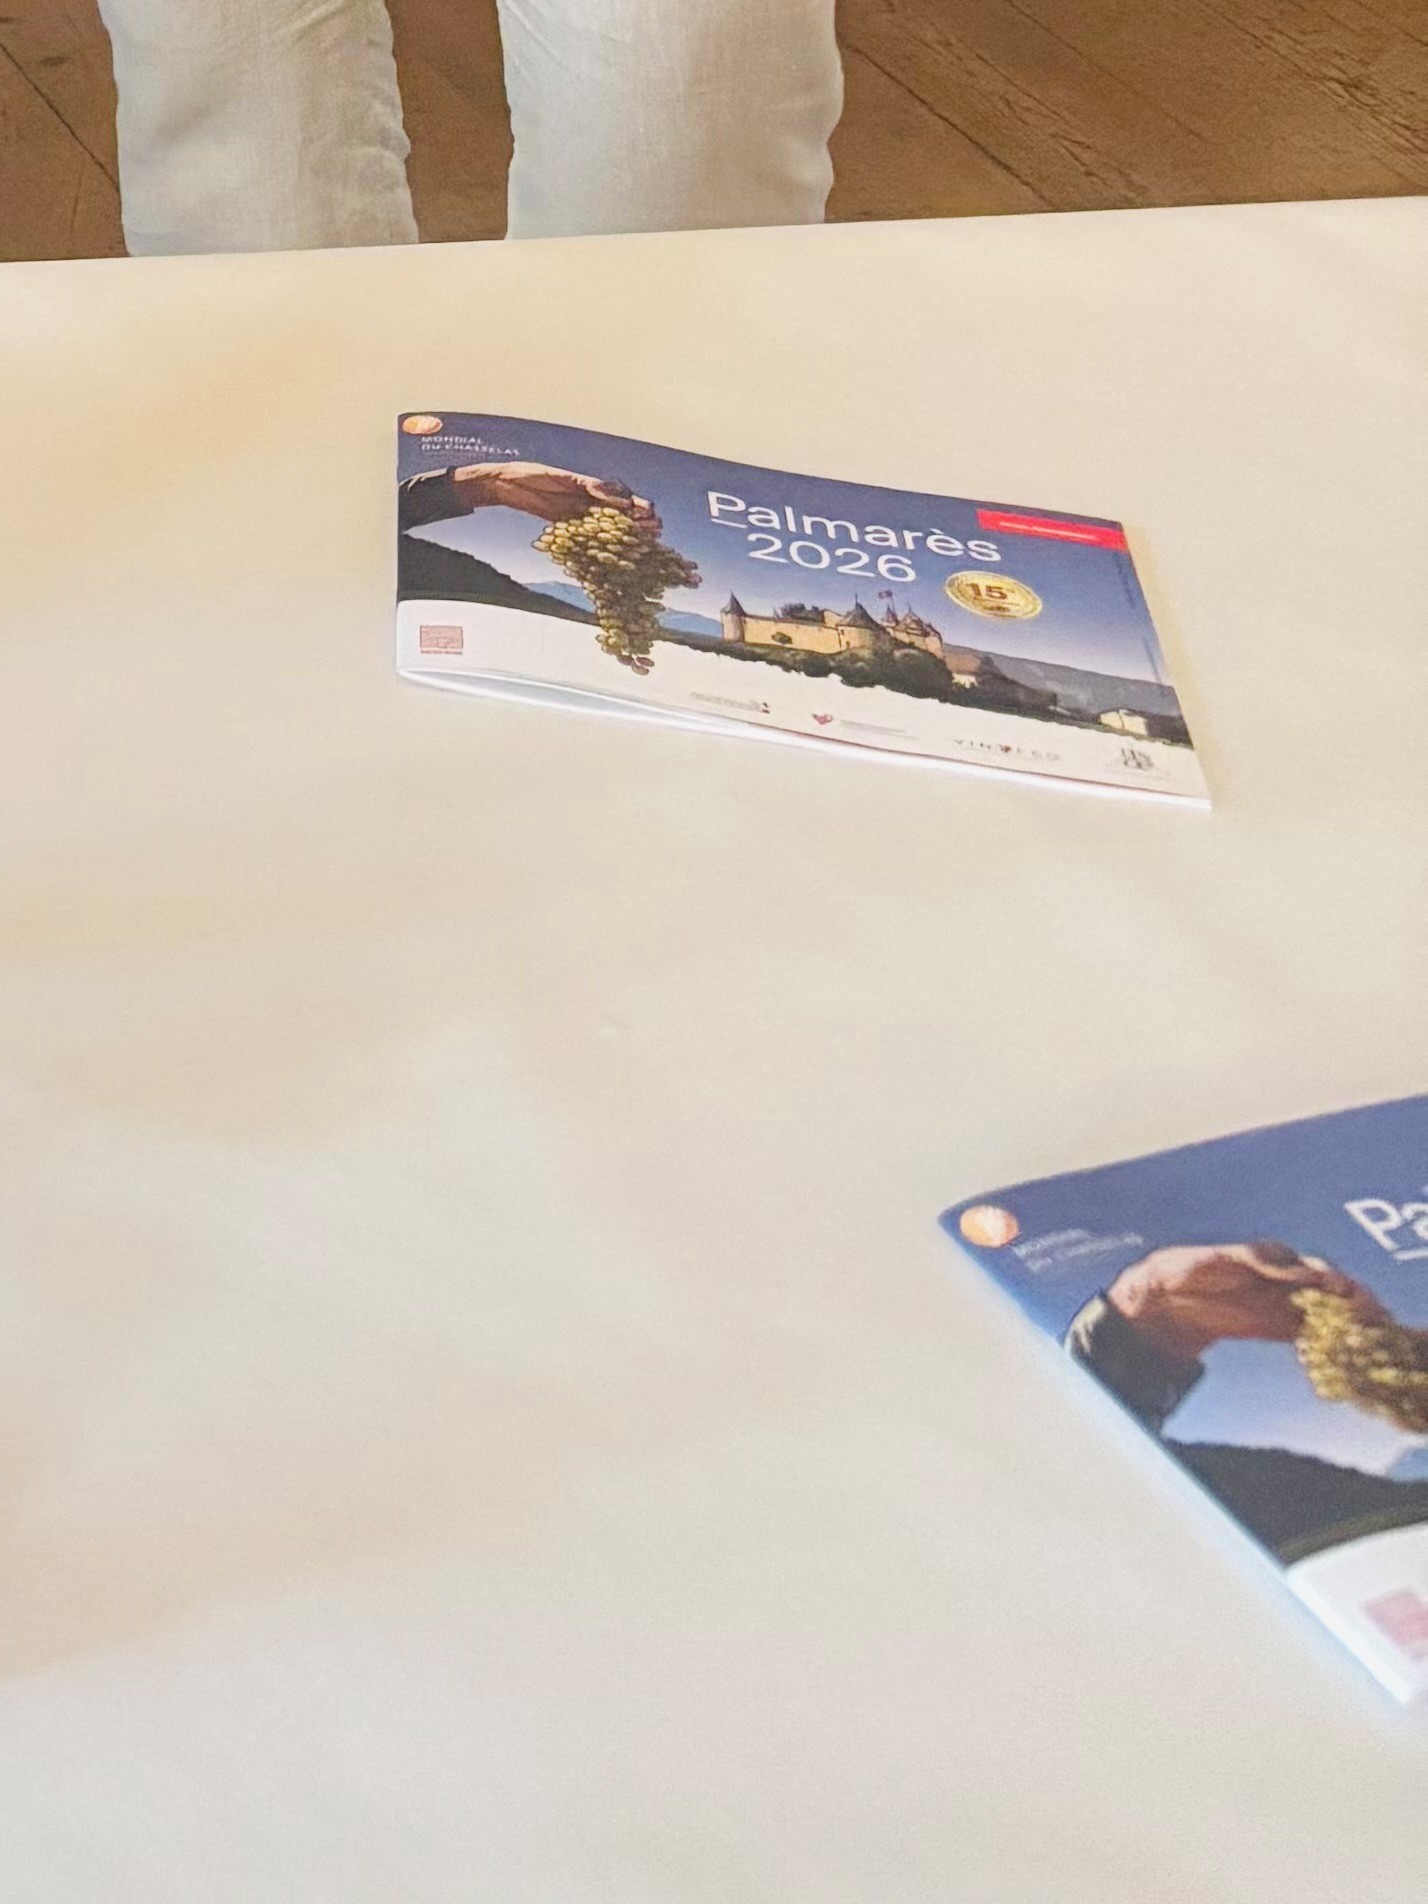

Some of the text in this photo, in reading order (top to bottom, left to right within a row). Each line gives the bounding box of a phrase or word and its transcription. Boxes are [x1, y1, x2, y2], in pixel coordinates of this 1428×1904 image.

[706, 490, 1003, 562] Palmarès
[746, 532, 918, 584] 2026
[1343, 1185, 1428, 1252] Pa
